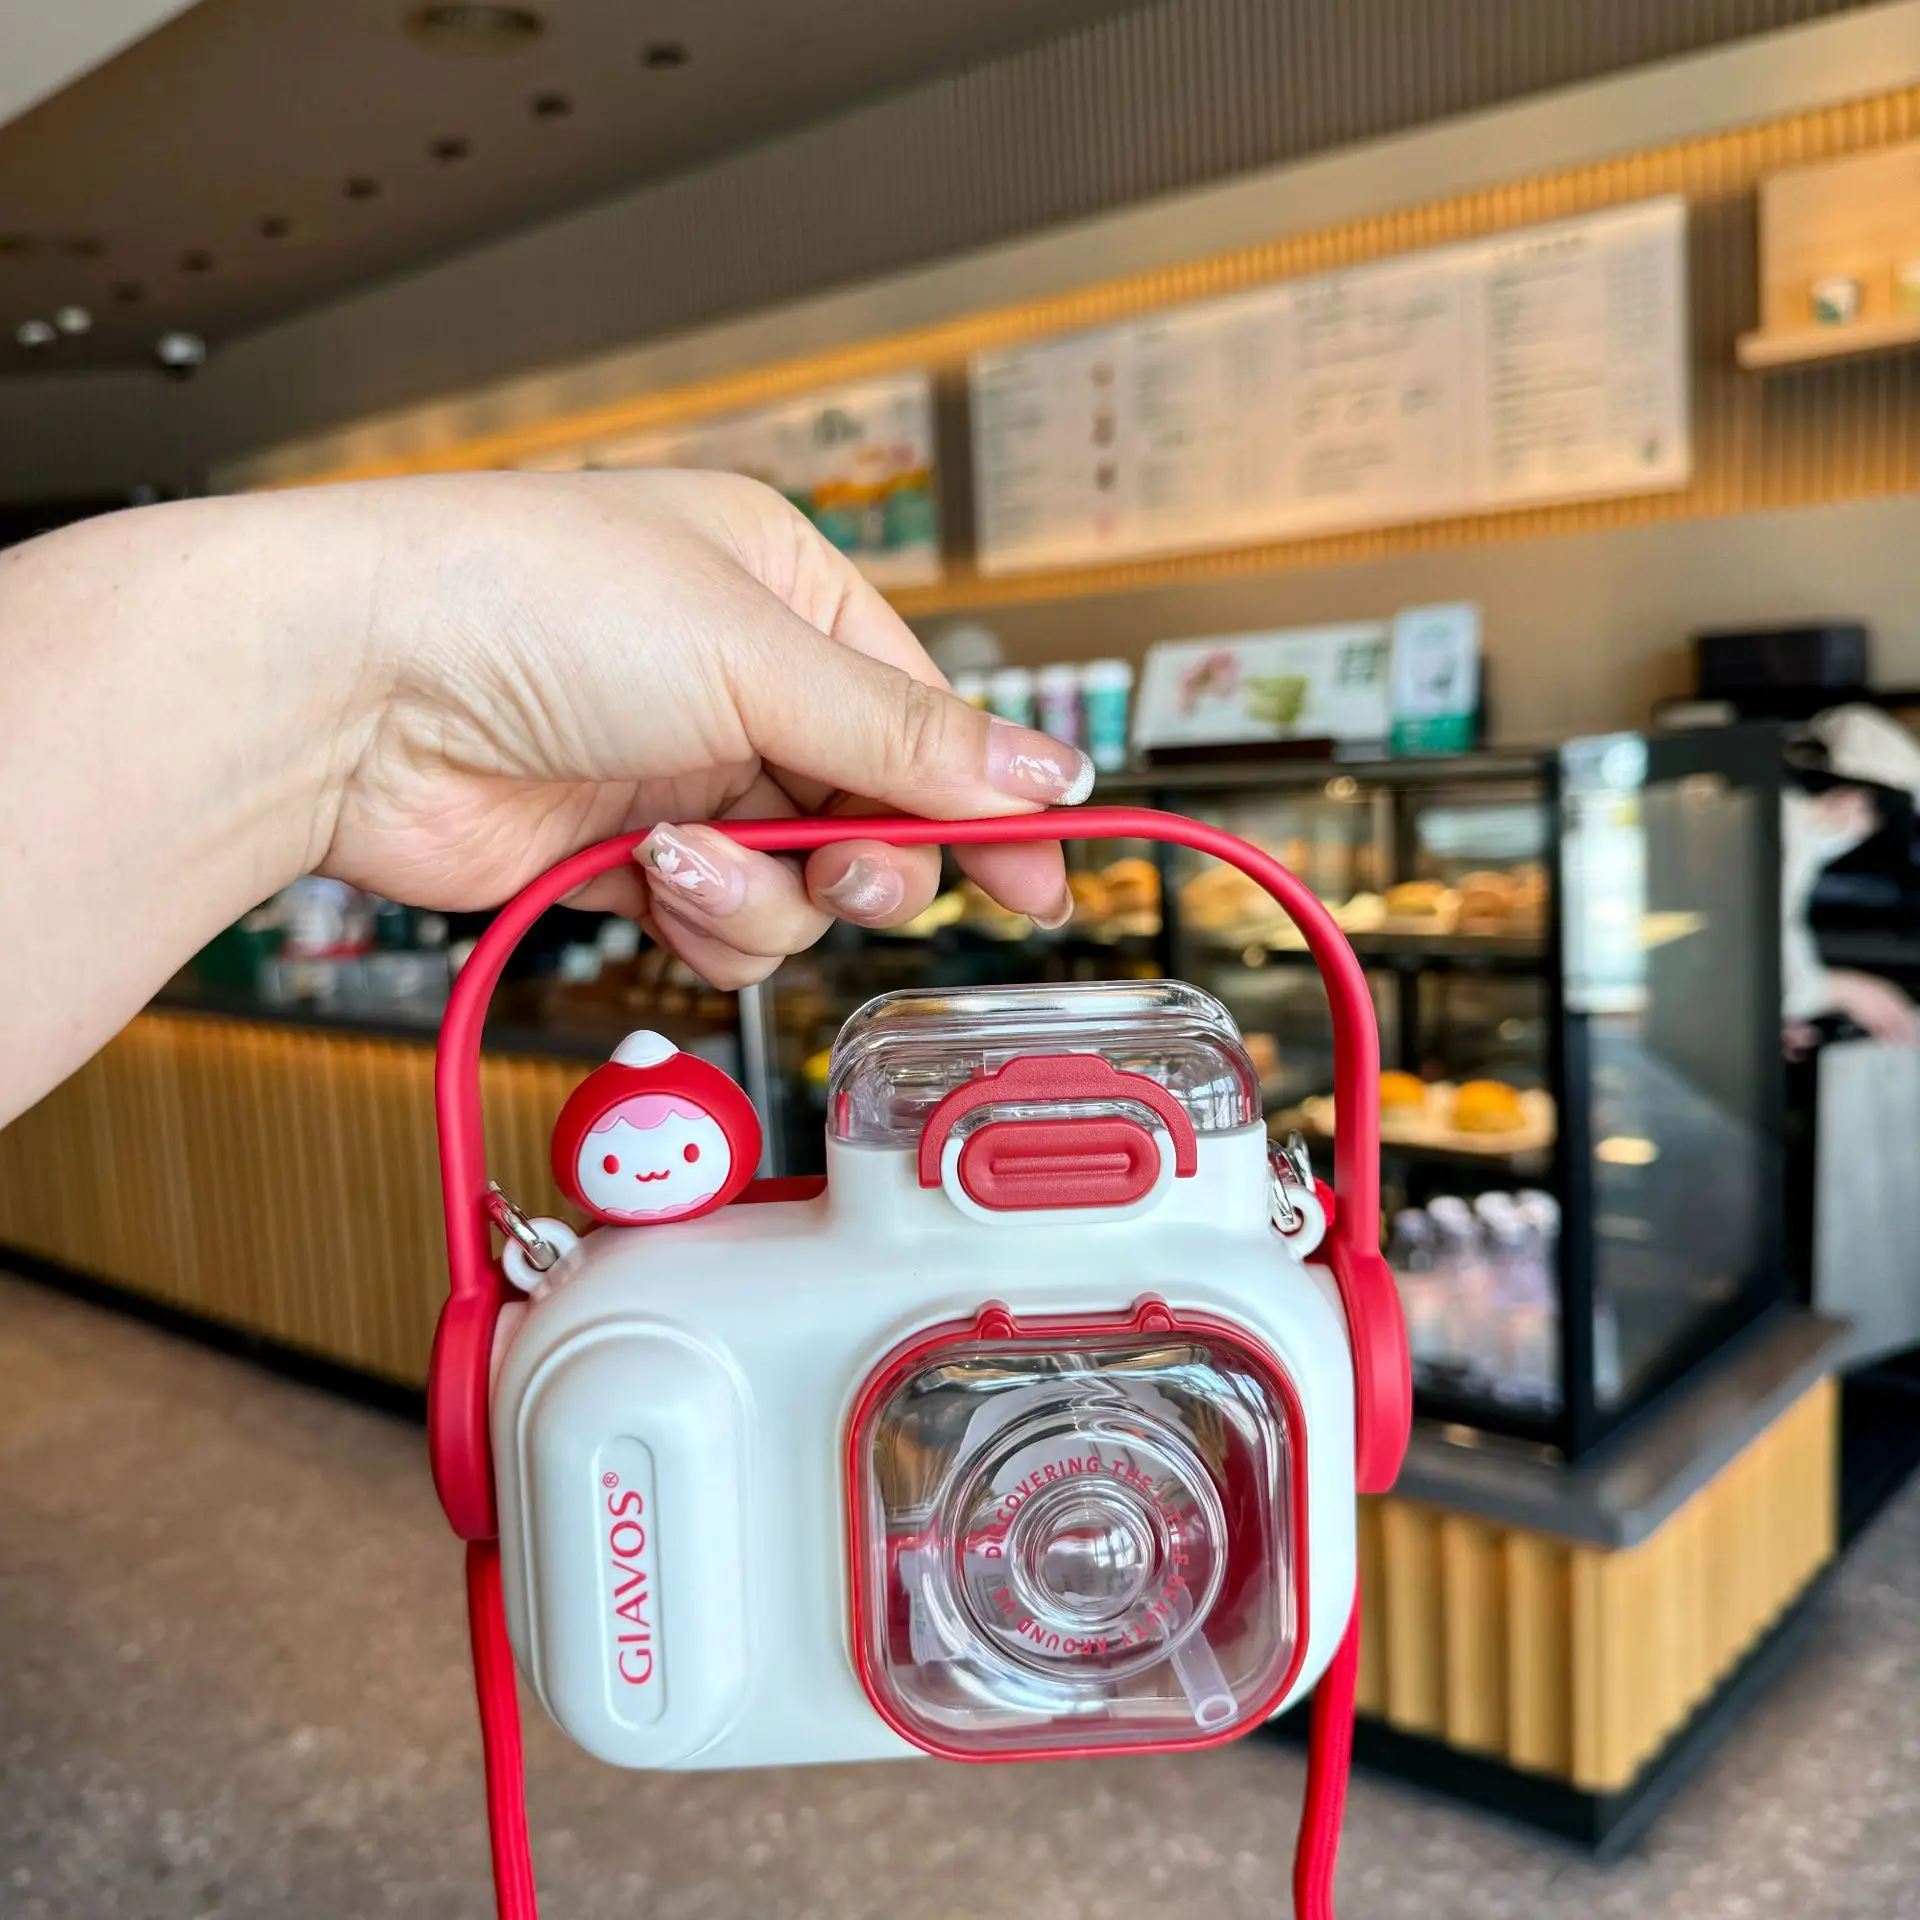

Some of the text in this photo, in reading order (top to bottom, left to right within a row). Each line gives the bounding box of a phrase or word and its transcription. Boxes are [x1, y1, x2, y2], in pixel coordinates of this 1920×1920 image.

[1112, 1460, 1154, 1496] THE
[985, 1456, 1100, 1558] DISCOVERING
[993, 1588, 1017, 1616] US
[1016, 1617, 1107, 1656] AROUND
